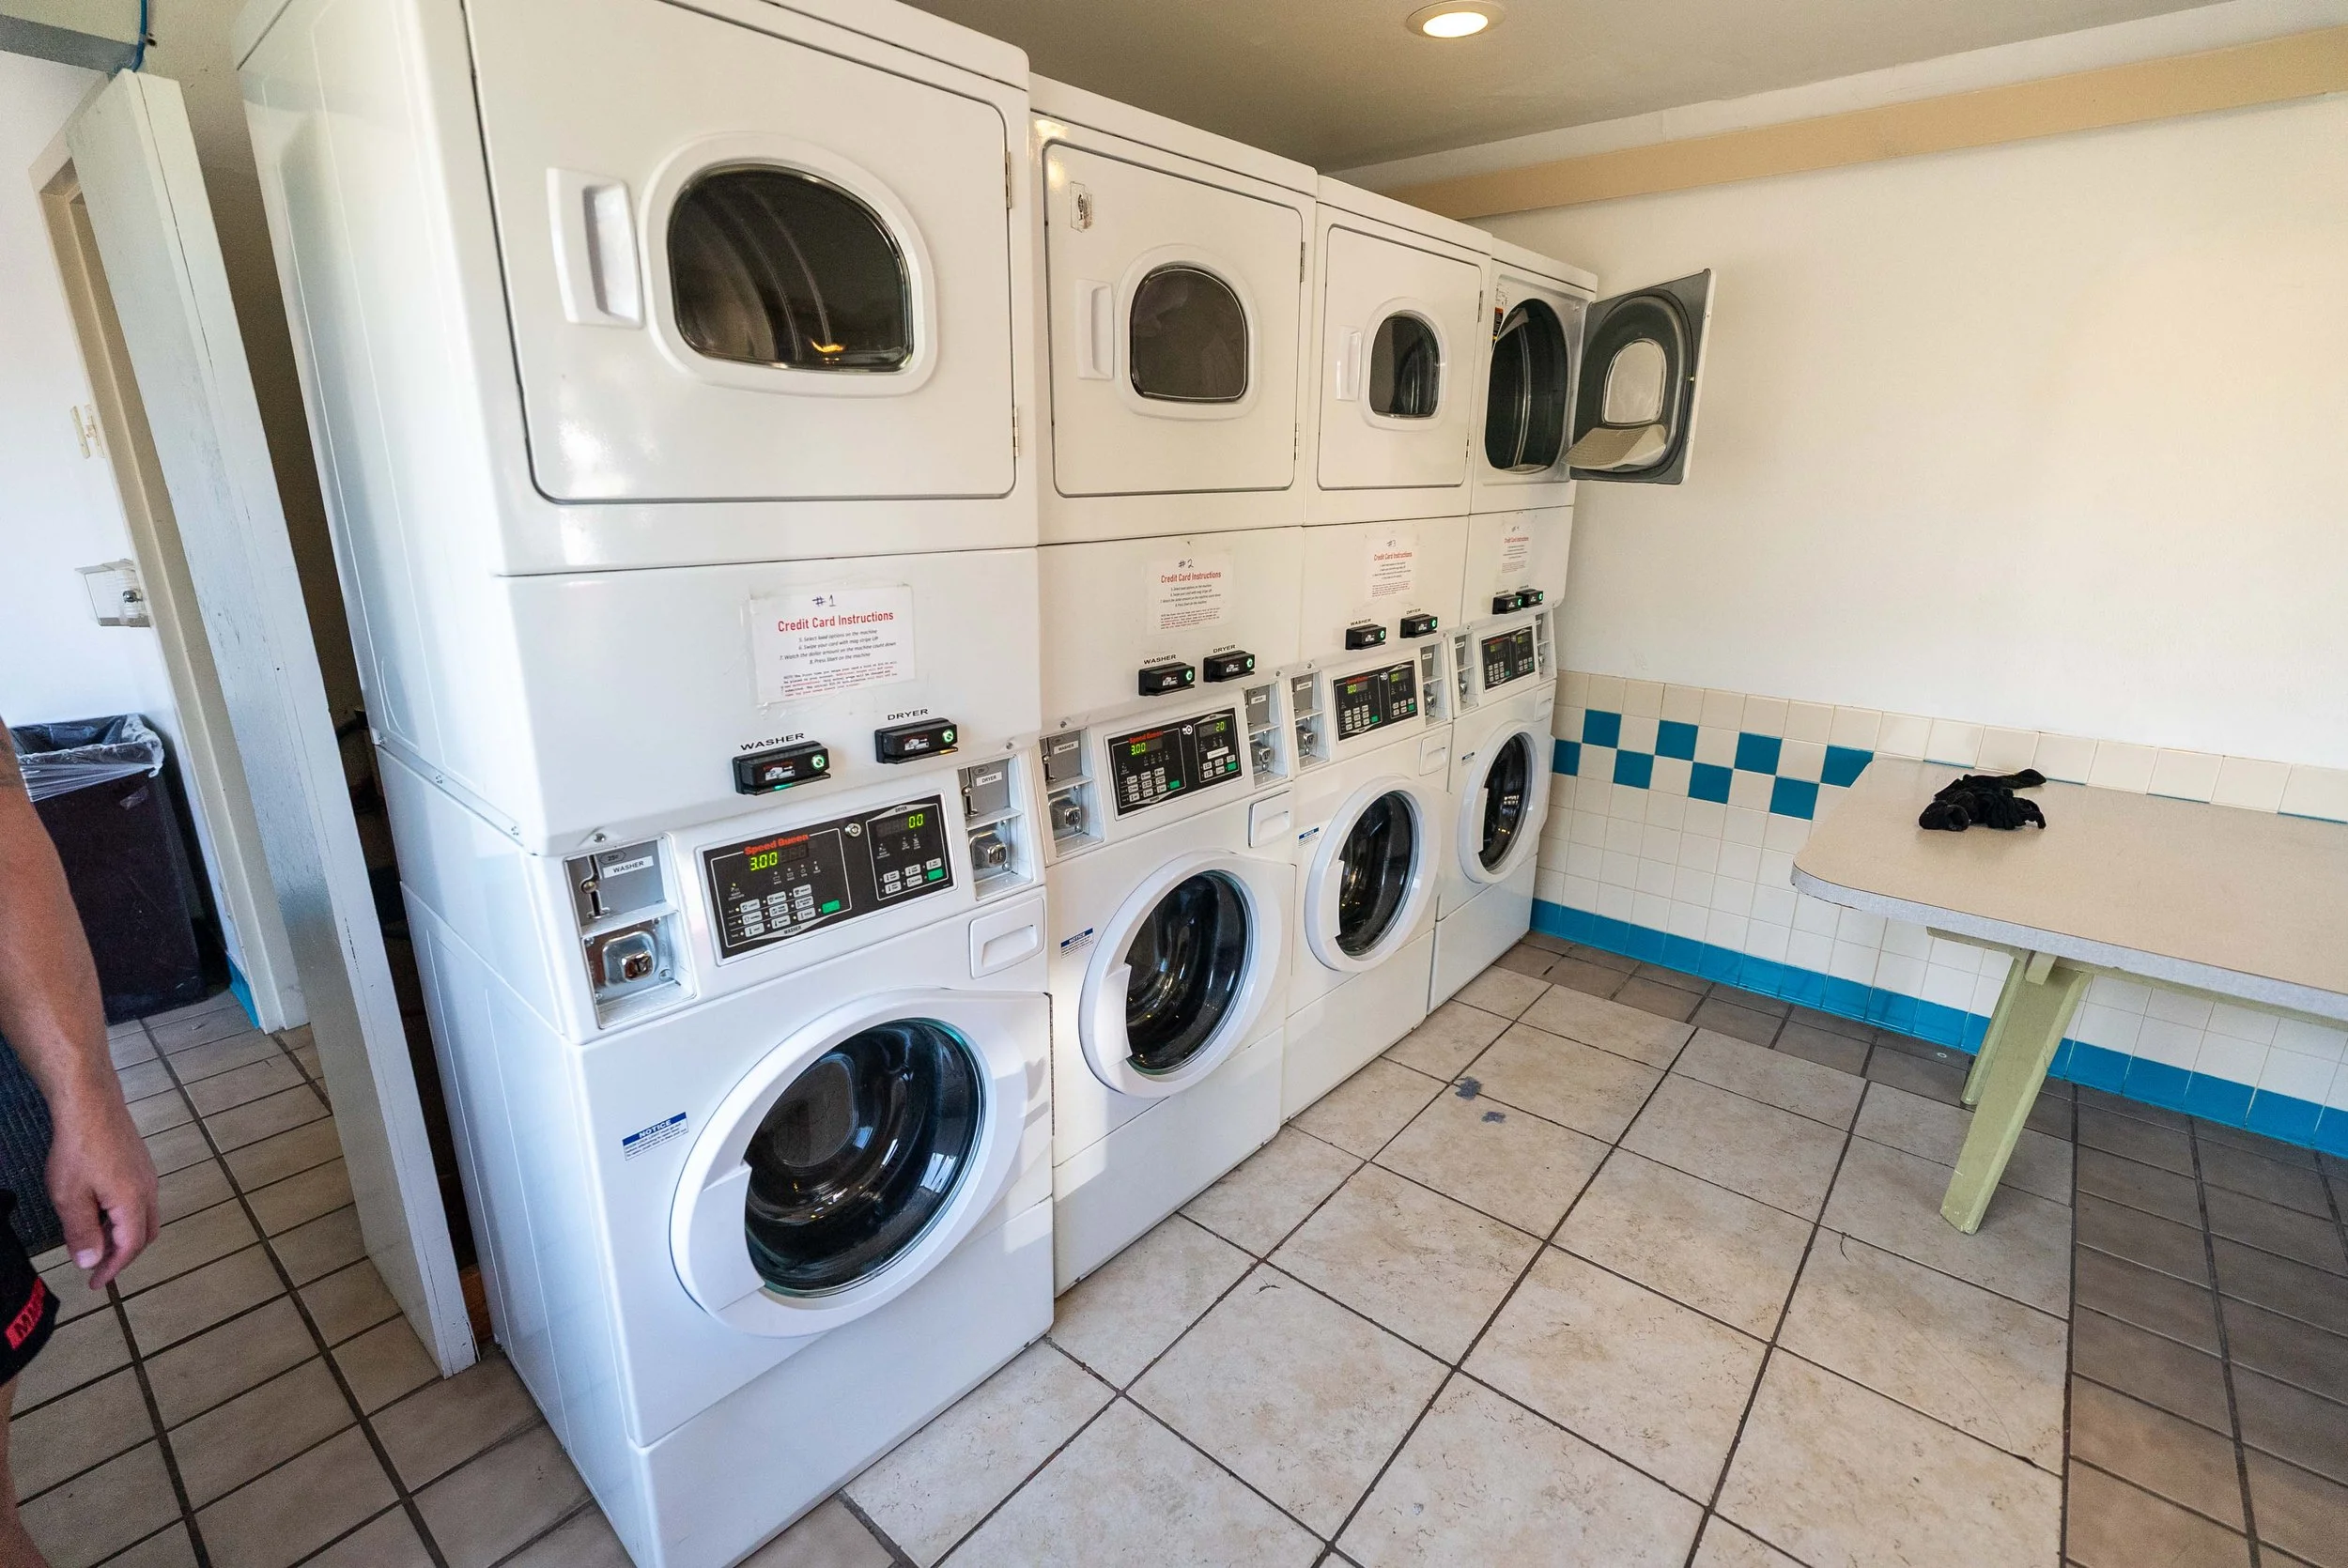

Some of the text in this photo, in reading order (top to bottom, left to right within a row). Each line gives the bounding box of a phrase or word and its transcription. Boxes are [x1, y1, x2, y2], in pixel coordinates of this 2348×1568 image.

[1178, 558, 1194, 568] #2
[1161, 571, 1221, 583] Credit Card Instructions
[778, 611, 894, 632] Credit Card Instructions
[1213, 644, 1236, 653] DRYER
[1143, 654, 1177, 664] WASHER
[887, 709, 929, 721] DRYER
[740, 733, 805, 751] WASHER
[908, 814, 923, 828] 00
[744, 834, 809, 855] Speed Queen
[613, 861, 644, 873] WASHER
[750, 851, 778, 871] 3.00
[639, 1120, 672, 1138] NOTICE
